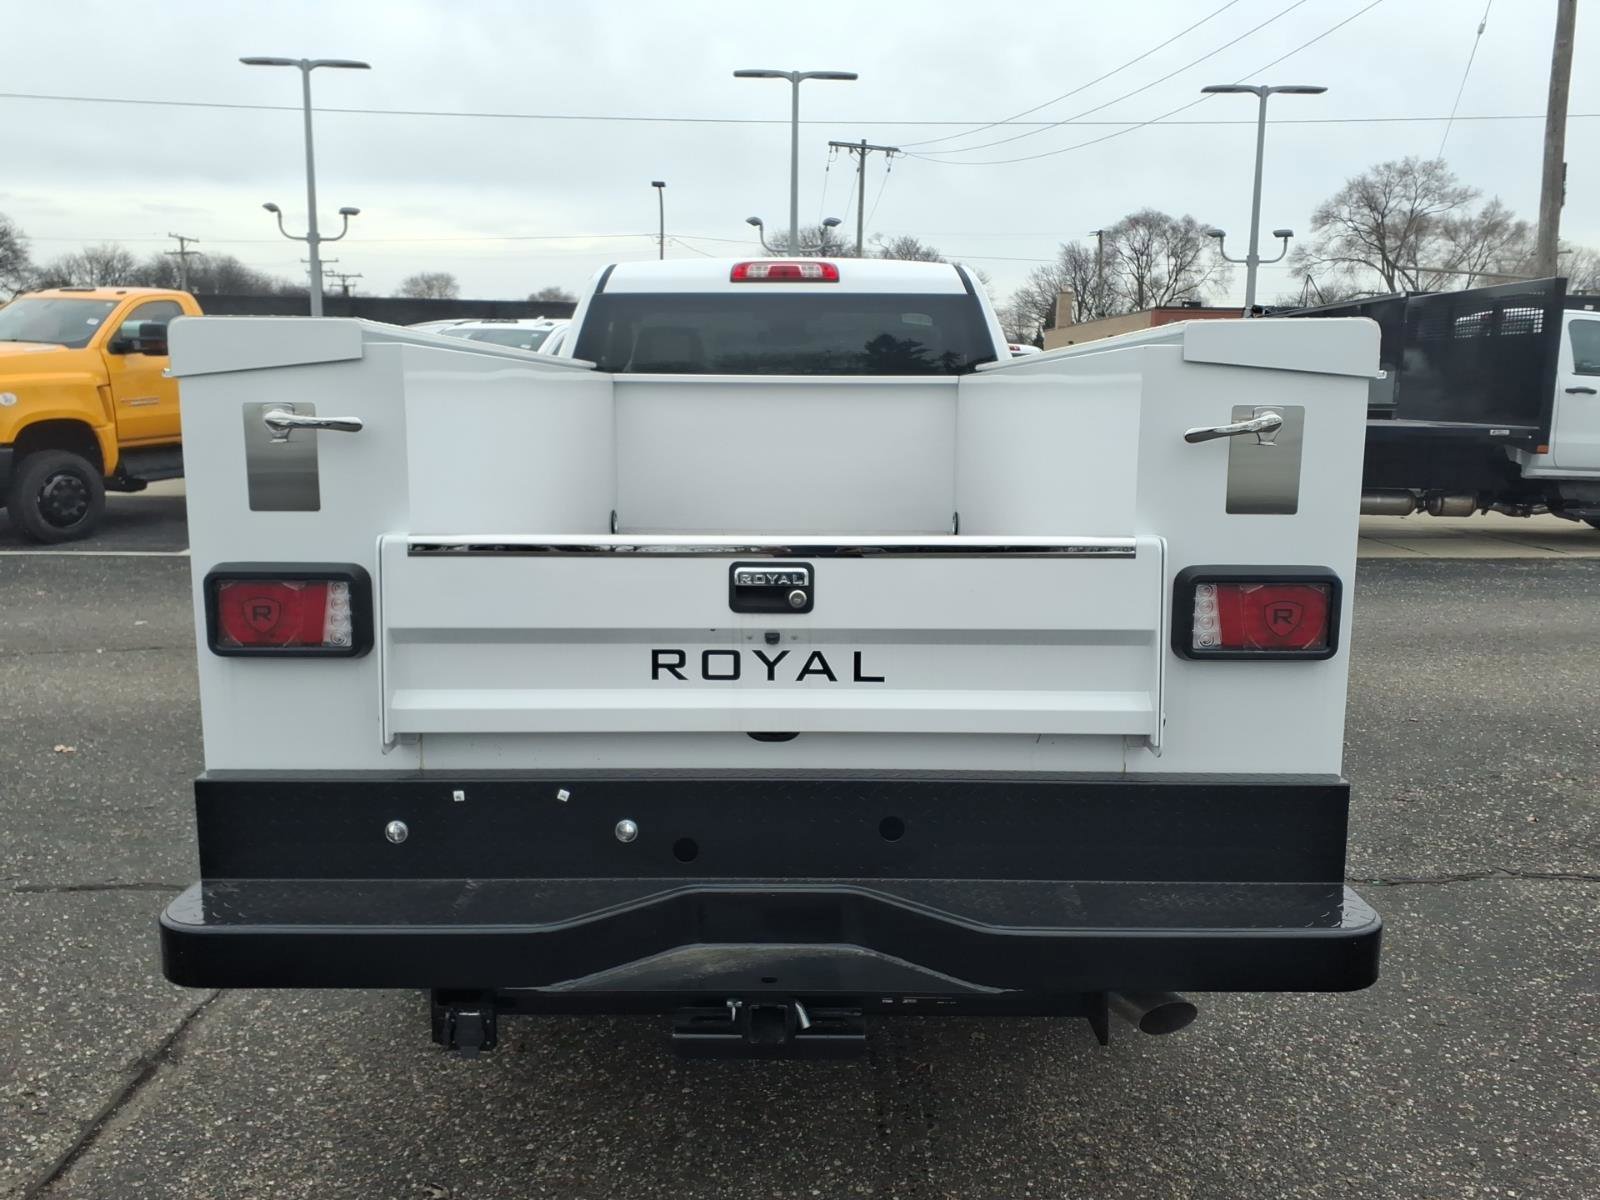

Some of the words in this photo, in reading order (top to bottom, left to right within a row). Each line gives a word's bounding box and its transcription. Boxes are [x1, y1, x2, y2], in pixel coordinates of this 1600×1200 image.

[740, 573, 804, 585] ROYAL
[252, 605, 273, 621] R
[1273, 608, 1294, 624] R
[651, 648, 886, 683] ROYAL
